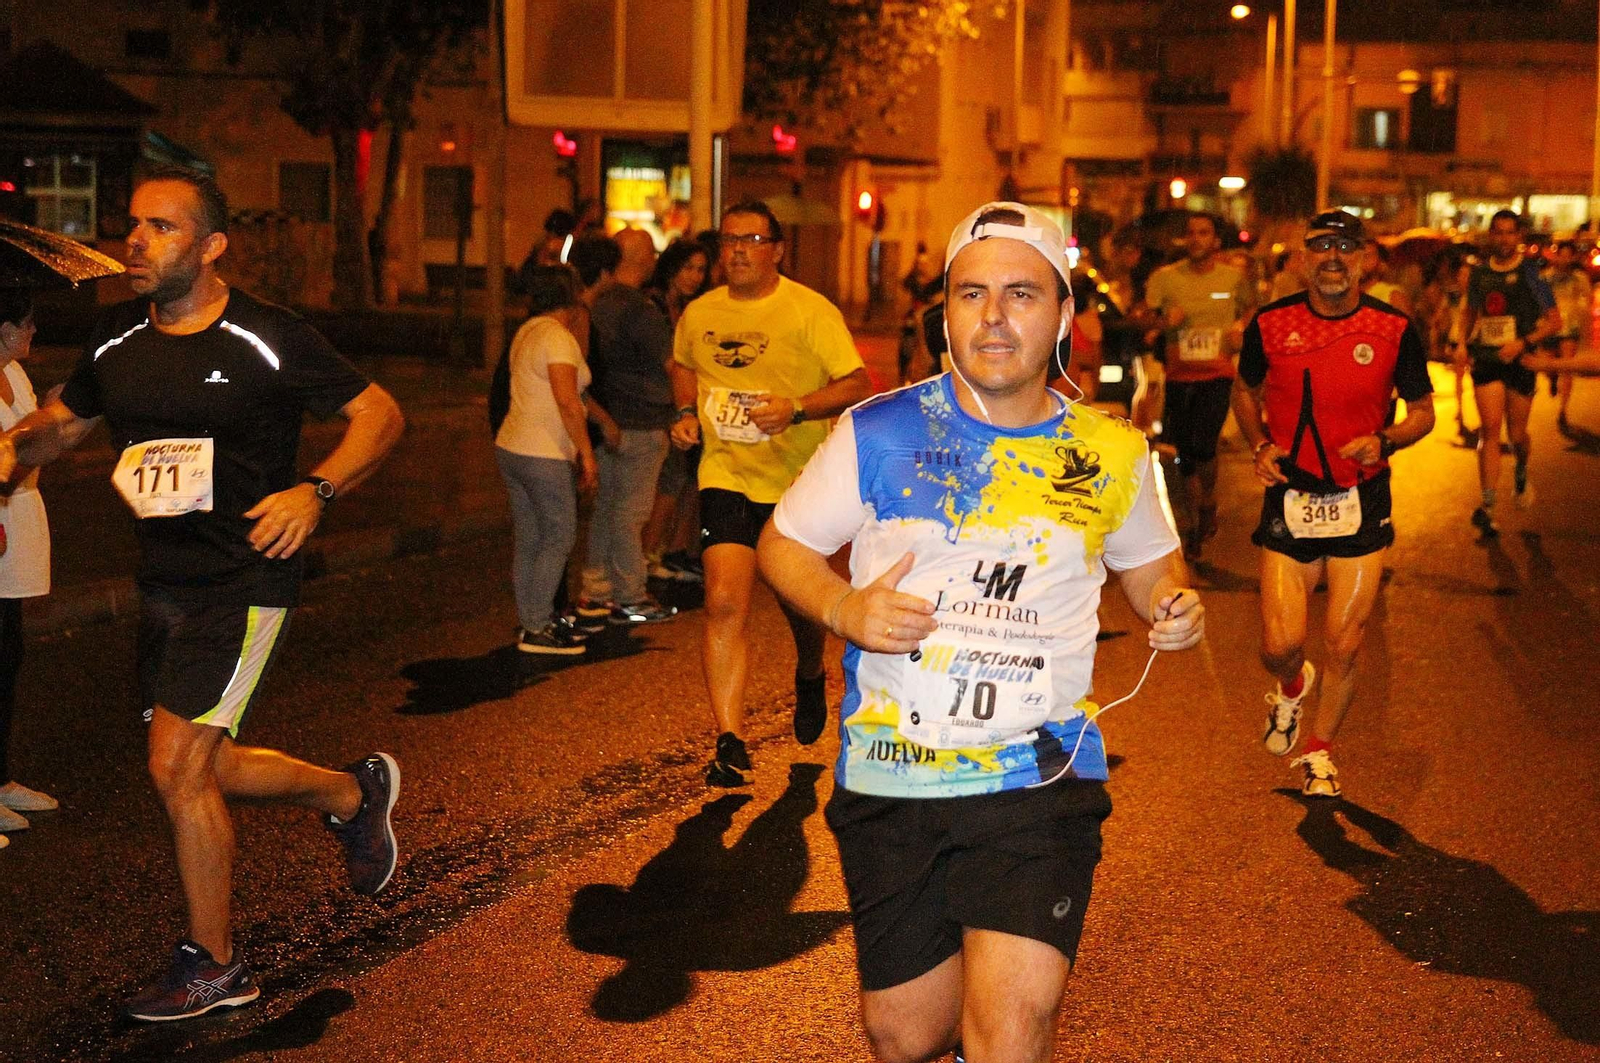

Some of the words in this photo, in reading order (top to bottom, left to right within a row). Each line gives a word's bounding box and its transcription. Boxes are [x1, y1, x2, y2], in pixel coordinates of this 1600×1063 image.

[717, 404, 750, 426] 575
[145, 444, 202, 456] NOCTURNA
[133, 464, 179, 494] 171
[1059, 512, 1087, 527] Run
[1302, 505, 1340, 523] 348
[973, 560, 1027, 601] LM
[935, 590, 1038, 625] Lorman
[938, 621, 983, 638] terapia
[988, 628, 998, 637] &
[948, 662, 972, 676] DE
[975, 665, 1034, 683] HUELVA
[948, 677, 997, 720] 70
